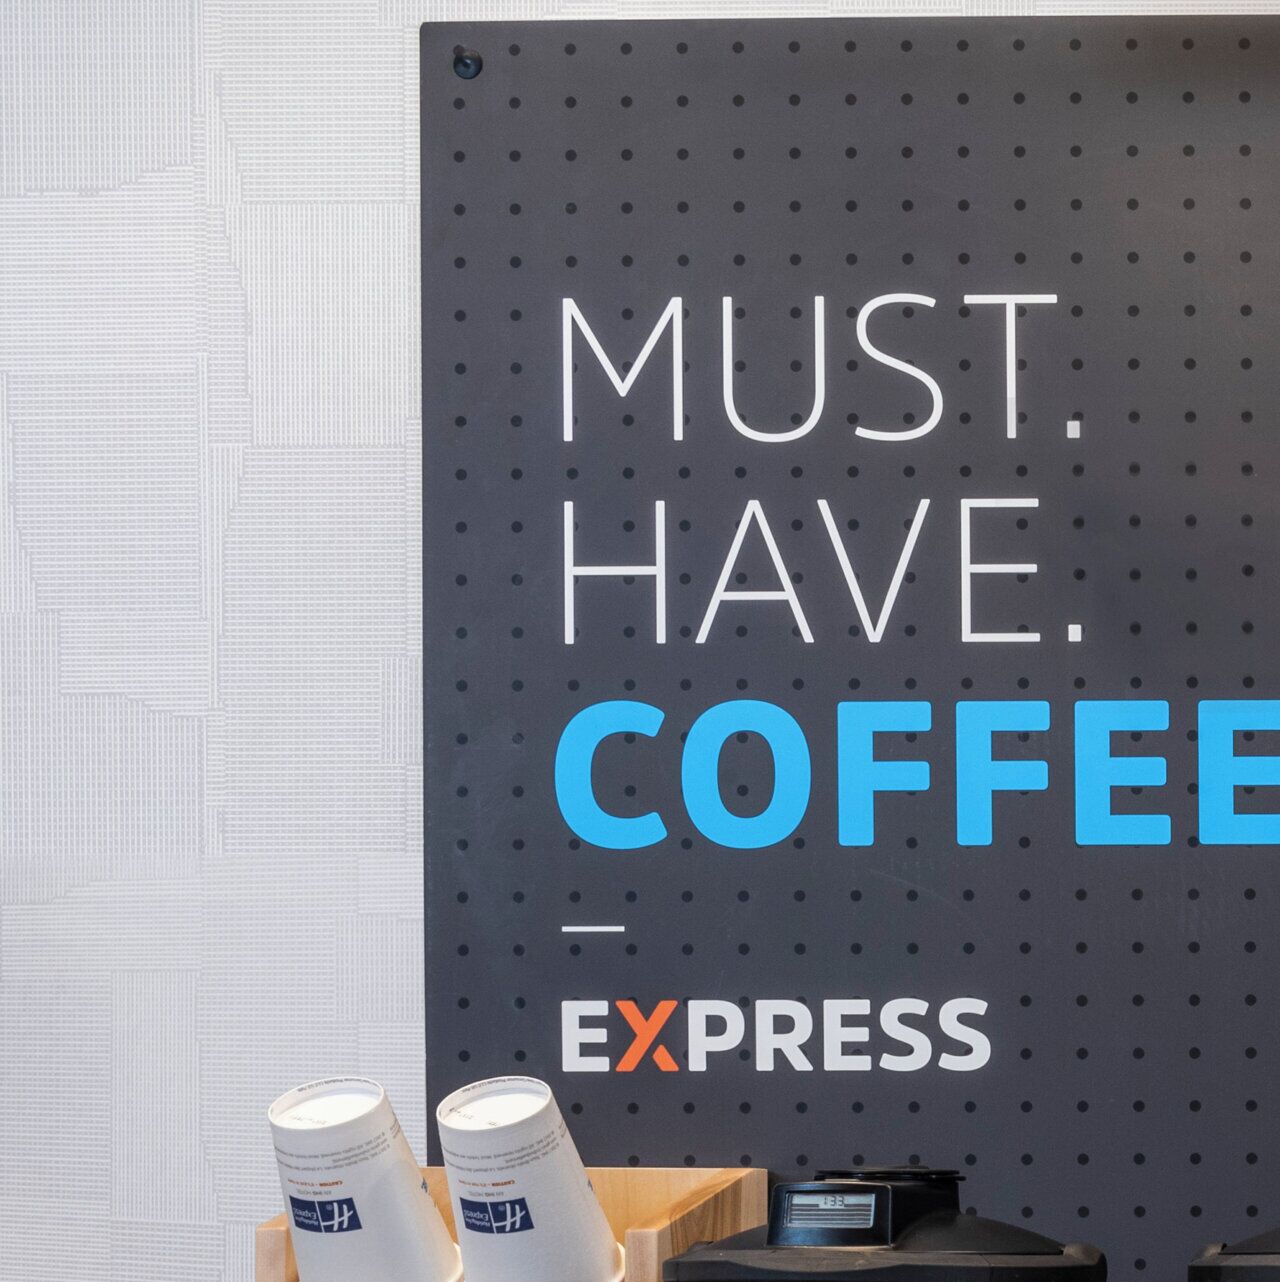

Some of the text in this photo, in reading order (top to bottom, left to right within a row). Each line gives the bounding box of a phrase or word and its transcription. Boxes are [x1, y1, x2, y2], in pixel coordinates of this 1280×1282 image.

[561, 292, 1082, 443] MUST.
[562, 497, 1083, 645] HAVE.
[561, 997, 992, 1073] EXPRESS
